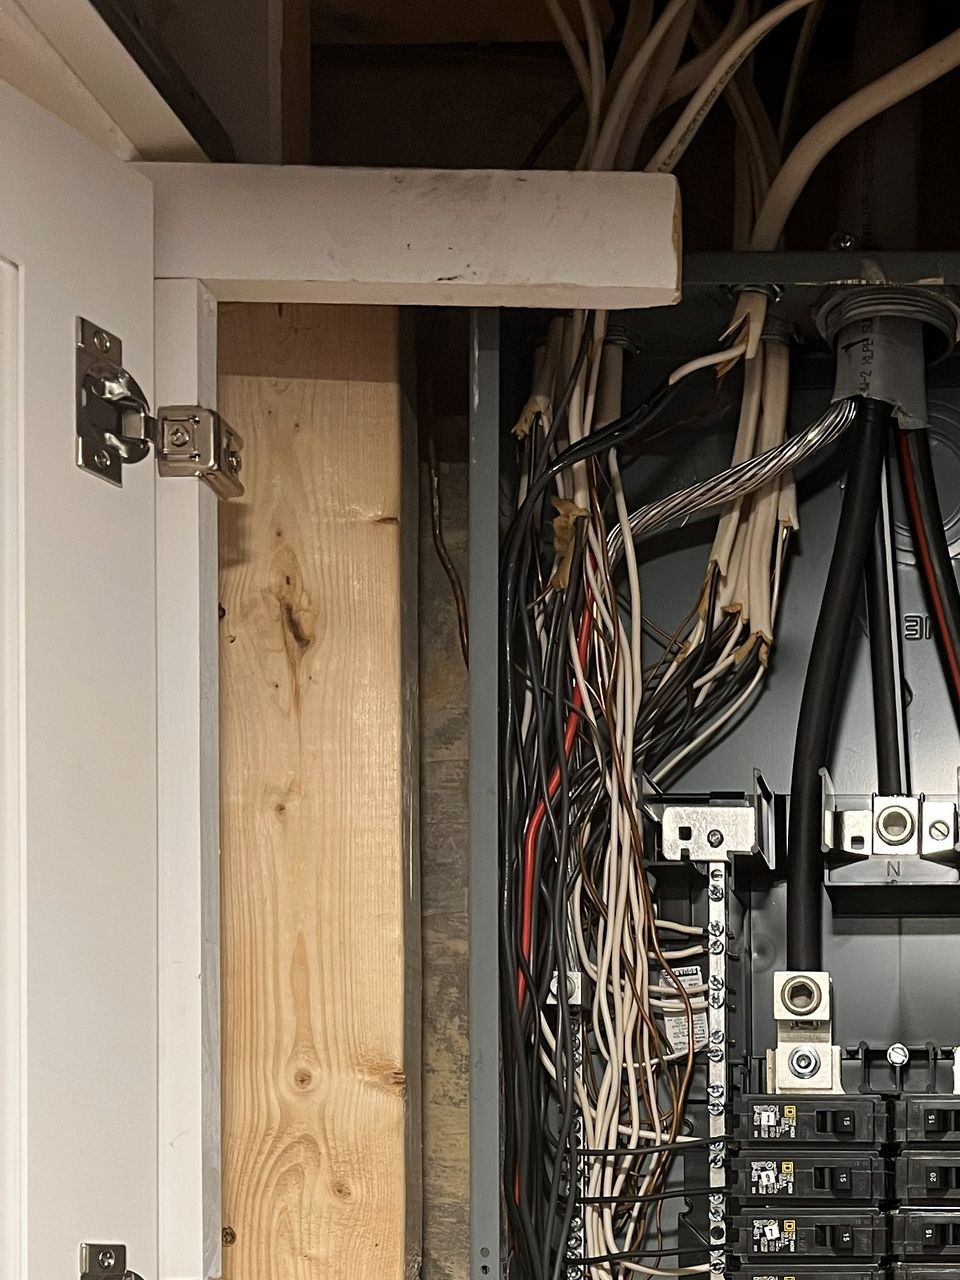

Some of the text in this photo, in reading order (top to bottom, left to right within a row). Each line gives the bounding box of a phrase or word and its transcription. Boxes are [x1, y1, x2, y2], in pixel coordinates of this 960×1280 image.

[886, 860, 901, 878] N
[843, 1116, 851, 1126] 15
[928, 1114, 936, 1124] 15
[840, 1173, 847, 1183] 15
[929, 1172, 937, 1182] 20
[842, 1232, 850, 1242] 15
[925, 1229, 933, 1238] 15
